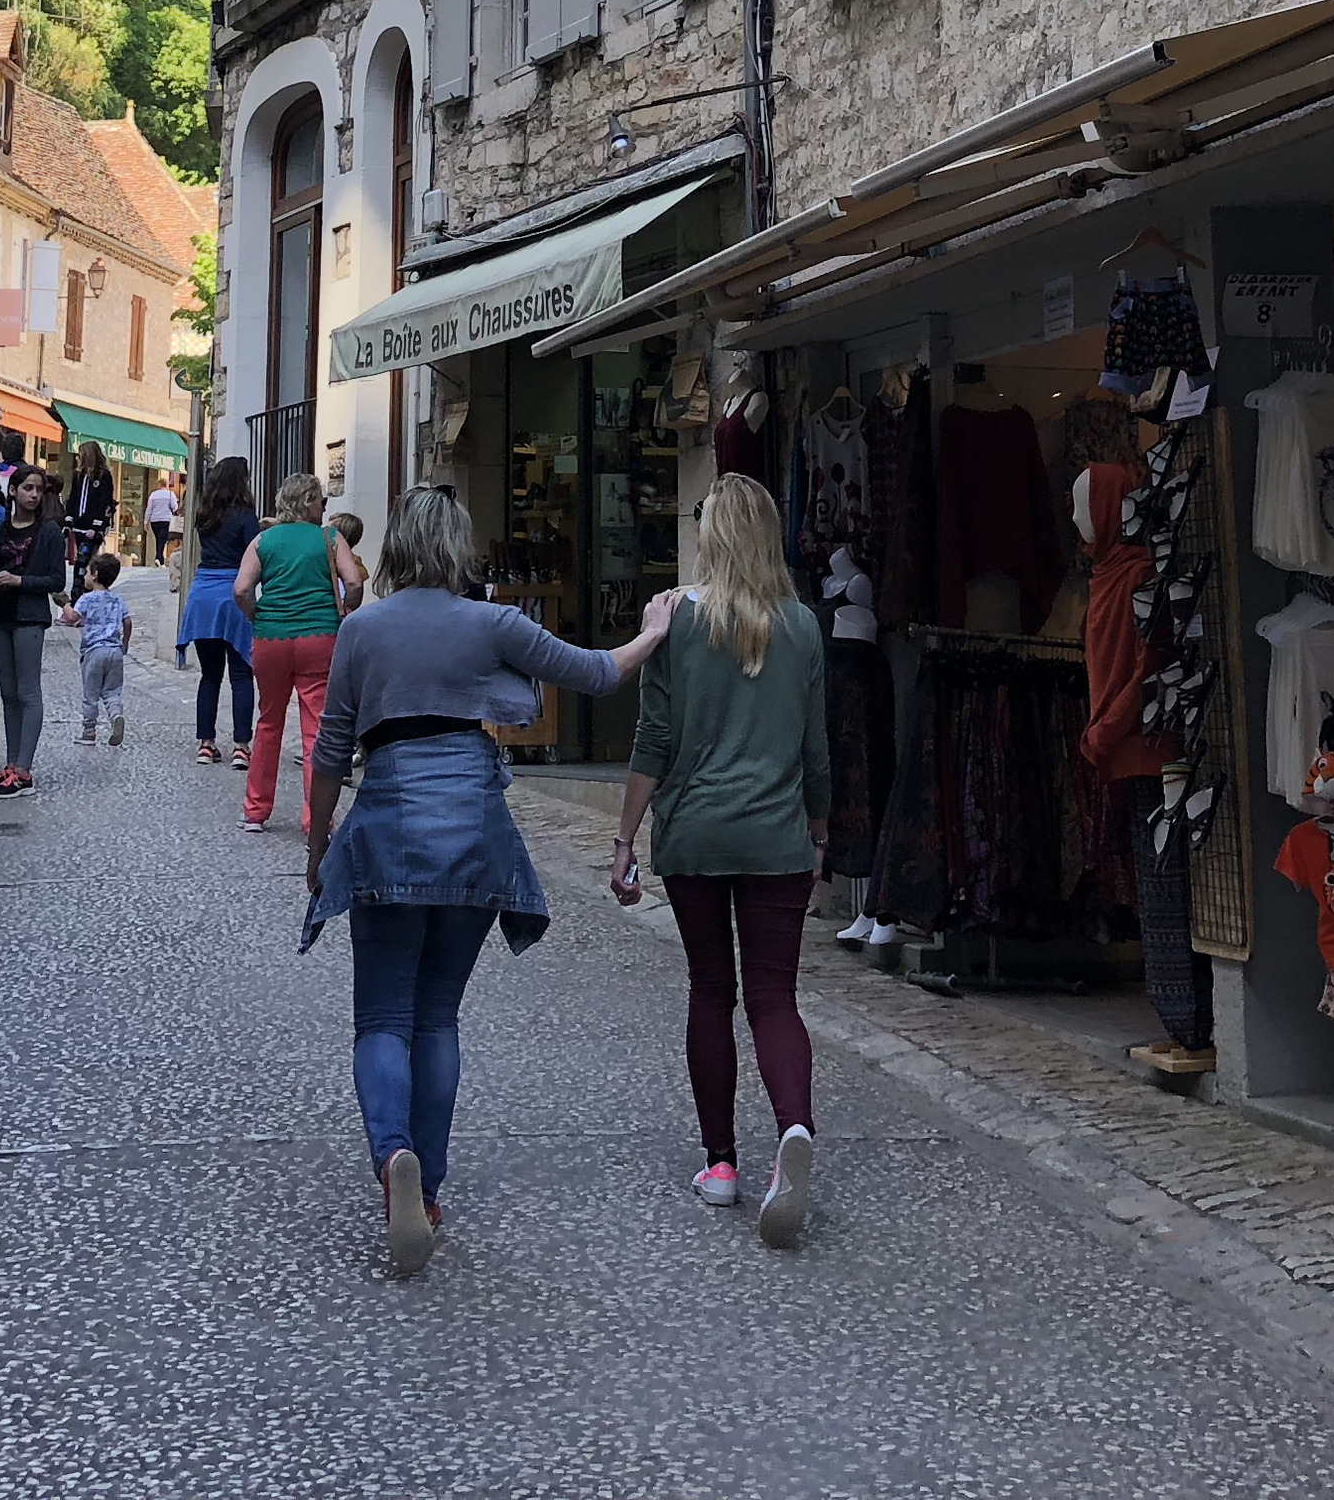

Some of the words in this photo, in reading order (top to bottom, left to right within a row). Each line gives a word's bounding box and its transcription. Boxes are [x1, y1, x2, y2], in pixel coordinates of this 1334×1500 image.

[1235, 286, 1299, 298] ENFANT
[354, 331, 373, 371] La
[383, 323, 422, 364] Boîte
[432, 319, 459, 353] aux
[469, 284, 575, 343] Chaussures
